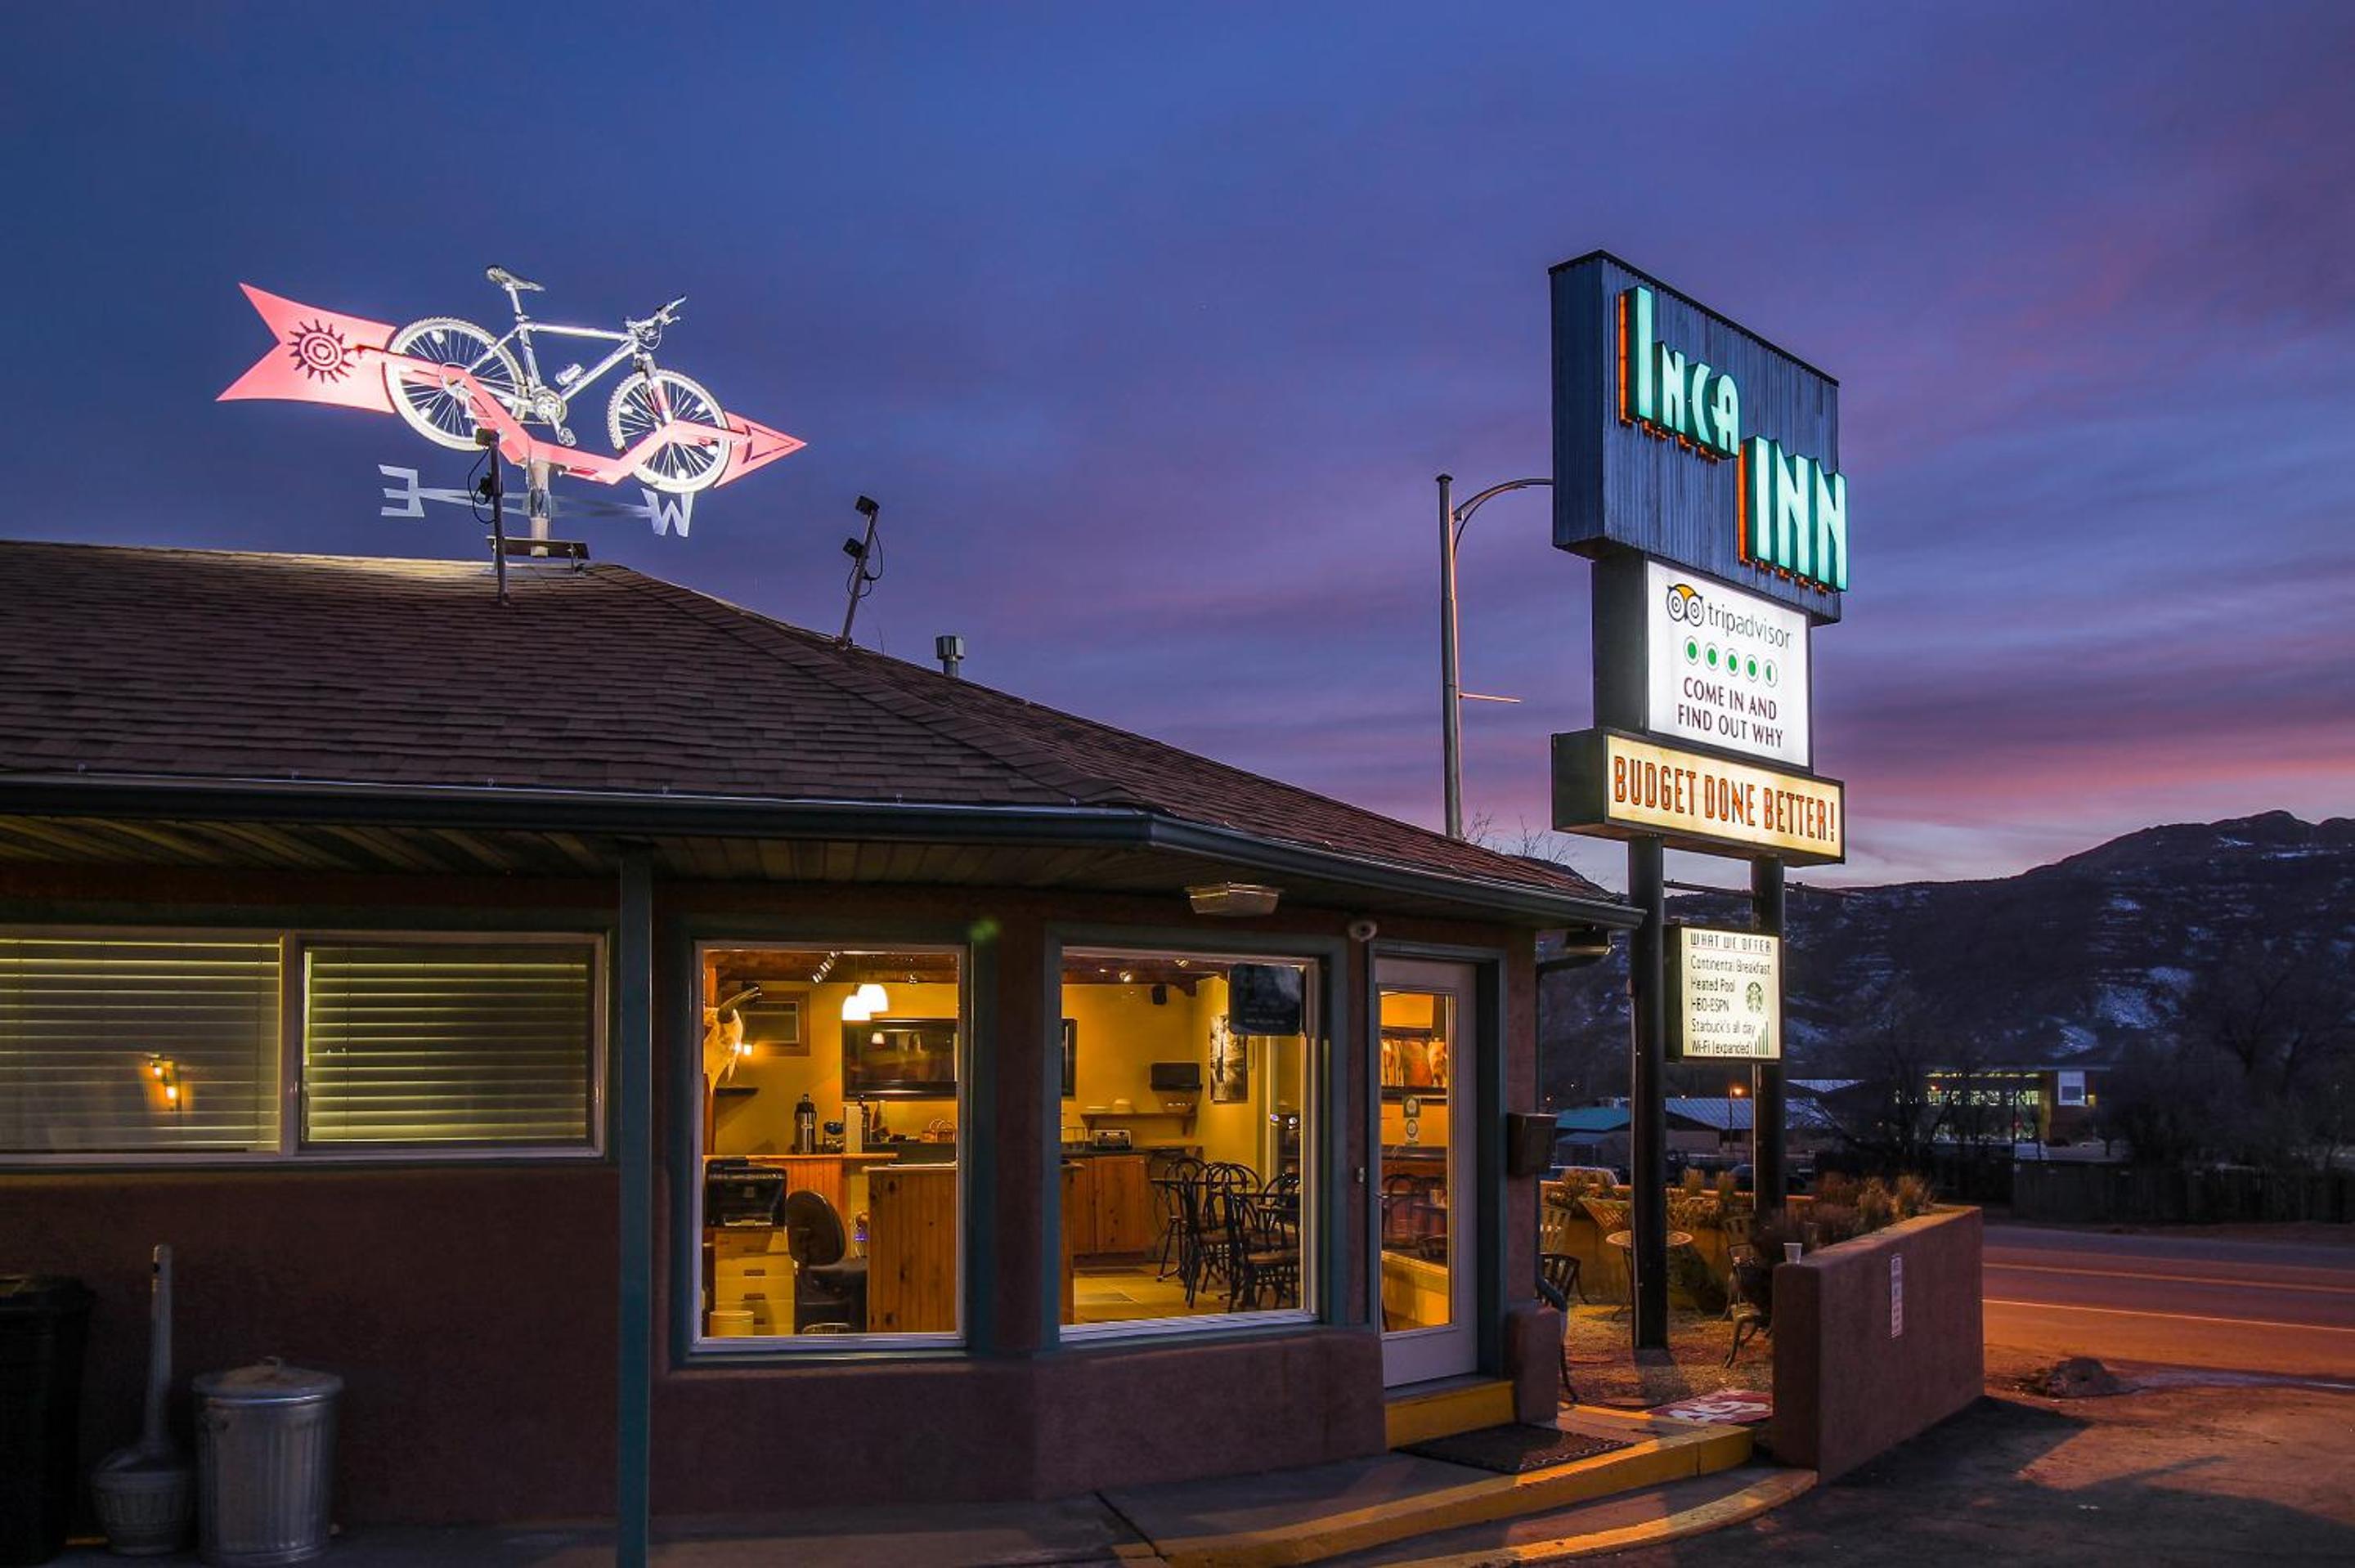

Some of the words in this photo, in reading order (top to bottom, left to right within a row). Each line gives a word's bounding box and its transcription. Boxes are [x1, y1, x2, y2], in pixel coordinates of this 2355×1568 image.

[1622, 286, 1739, 458] INCA
[1743, 436, 1848, 592] INN
[1707, 602, 1792, 649] tripadvisor
[1684, 677, 1725, 707] COME
[1729, 689, 1744, 714] IN
[1748, 692, 1777, 721] AND
[1678, 704, 1712, 731] FIND
[1718, 715, 1747, 739] OUT
[1752, 723, 1783, 748] WHY
[1614, 755, 1696, 816] BUDGET
[1704, 774, 1756, 827] DONE
[1764, 786, 1835, 842] BETTER!
[1690, 932, 1719, 948] WHAT
[1724, 936, 1737, 948] WE
[1742, 938, 1772, 952] OFFER
[1690, 977, 1718, 992] Heated
[1720, 978, 1735, 992] Pool
[1736, 958, 1772, 975] Breakfast
